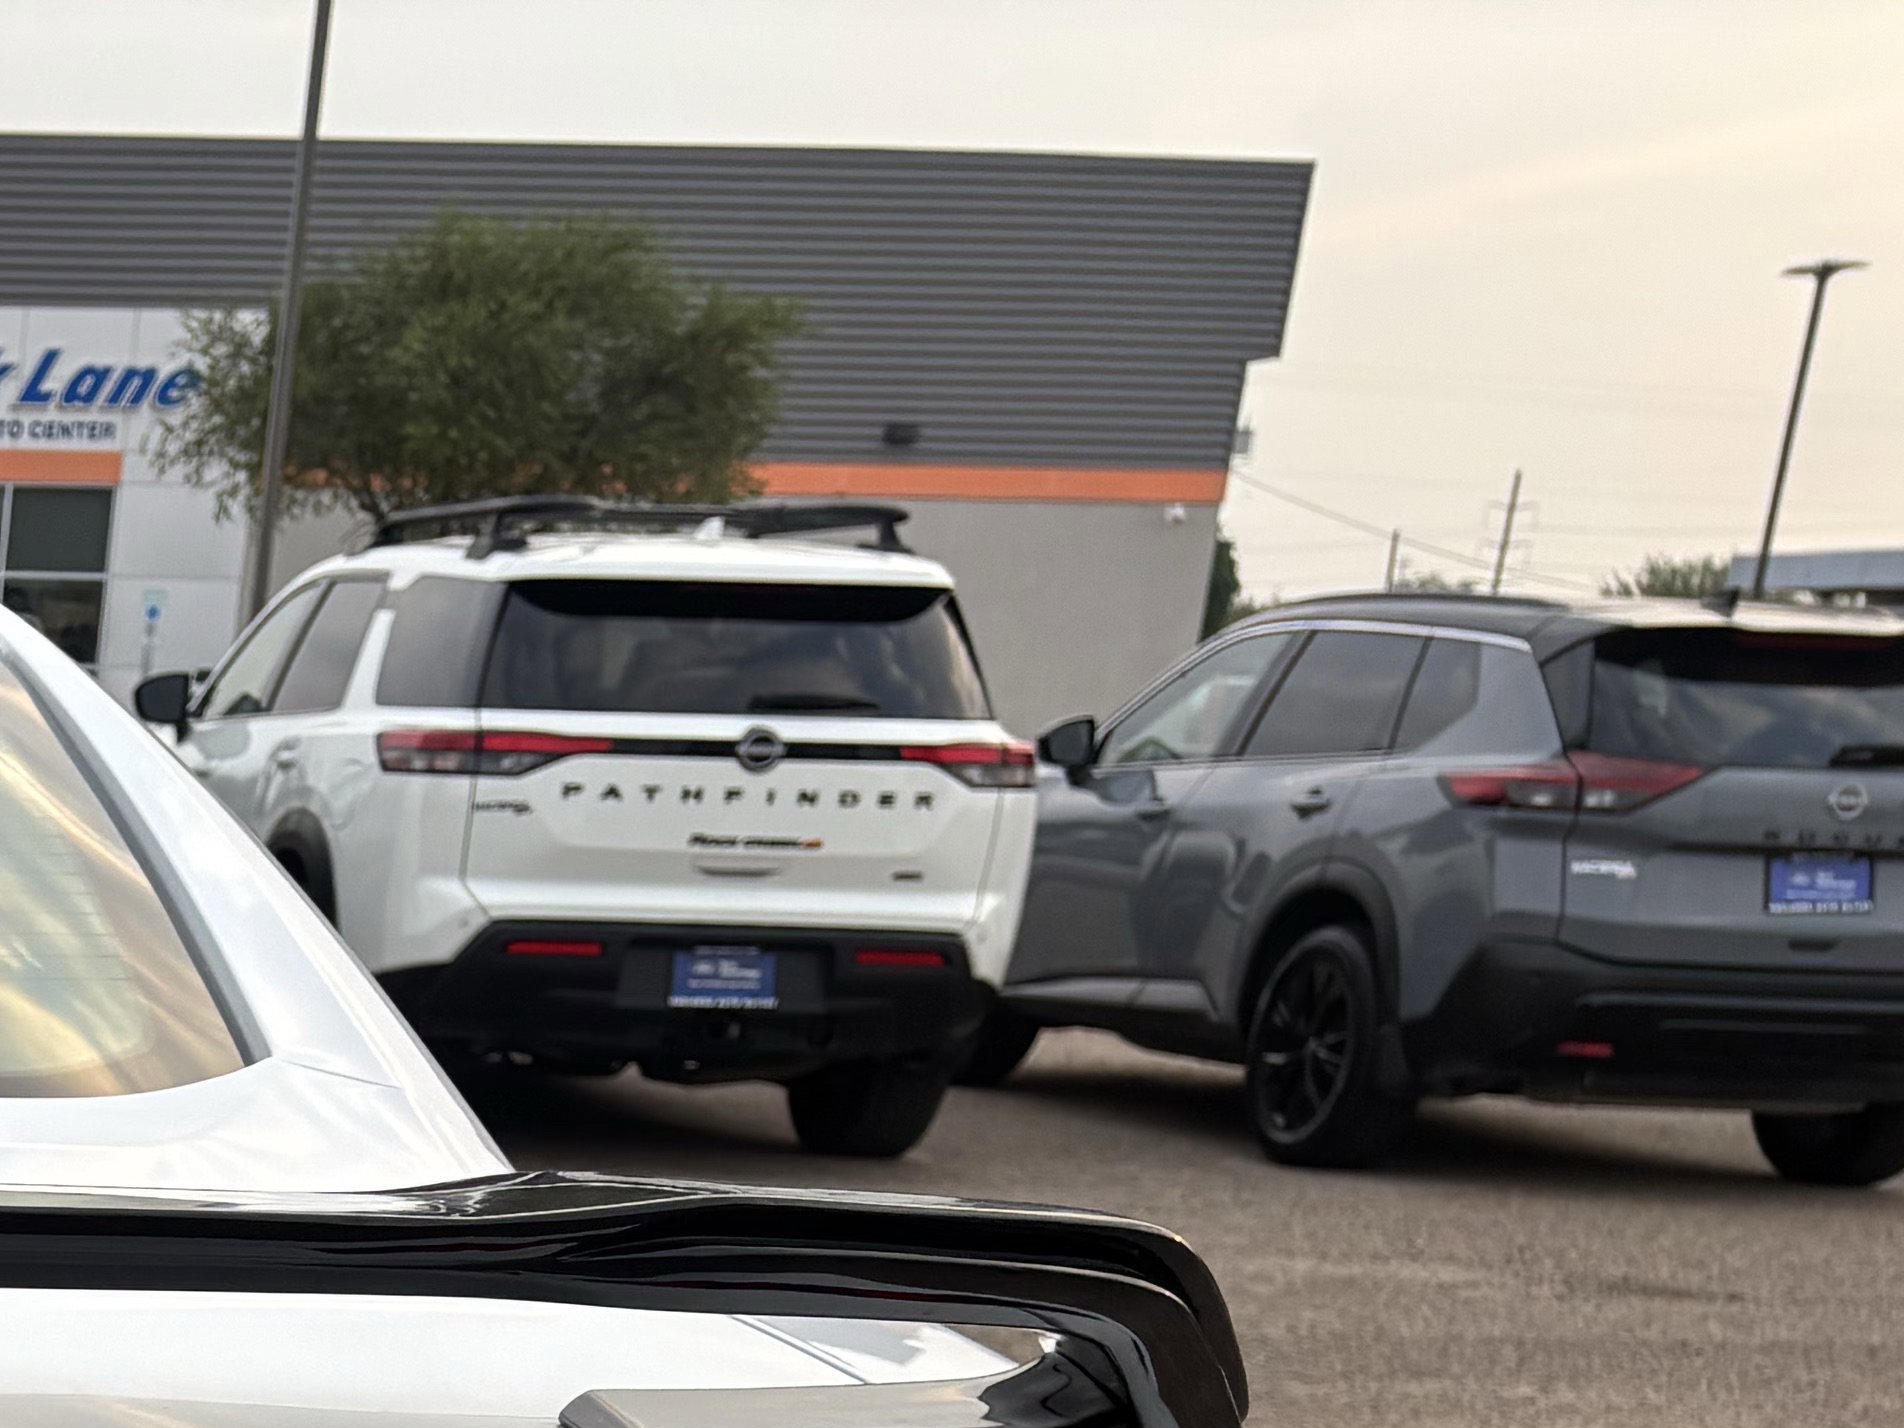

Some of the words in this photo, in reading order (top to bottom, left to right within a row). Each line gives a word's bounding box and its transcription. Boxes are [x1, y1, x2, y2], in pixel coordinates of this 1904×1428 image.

[19, 348, 201, 408] Lane
[27, 420, 117, 442] CENTER
[560, 782, 935, 810] PATHFINDER
